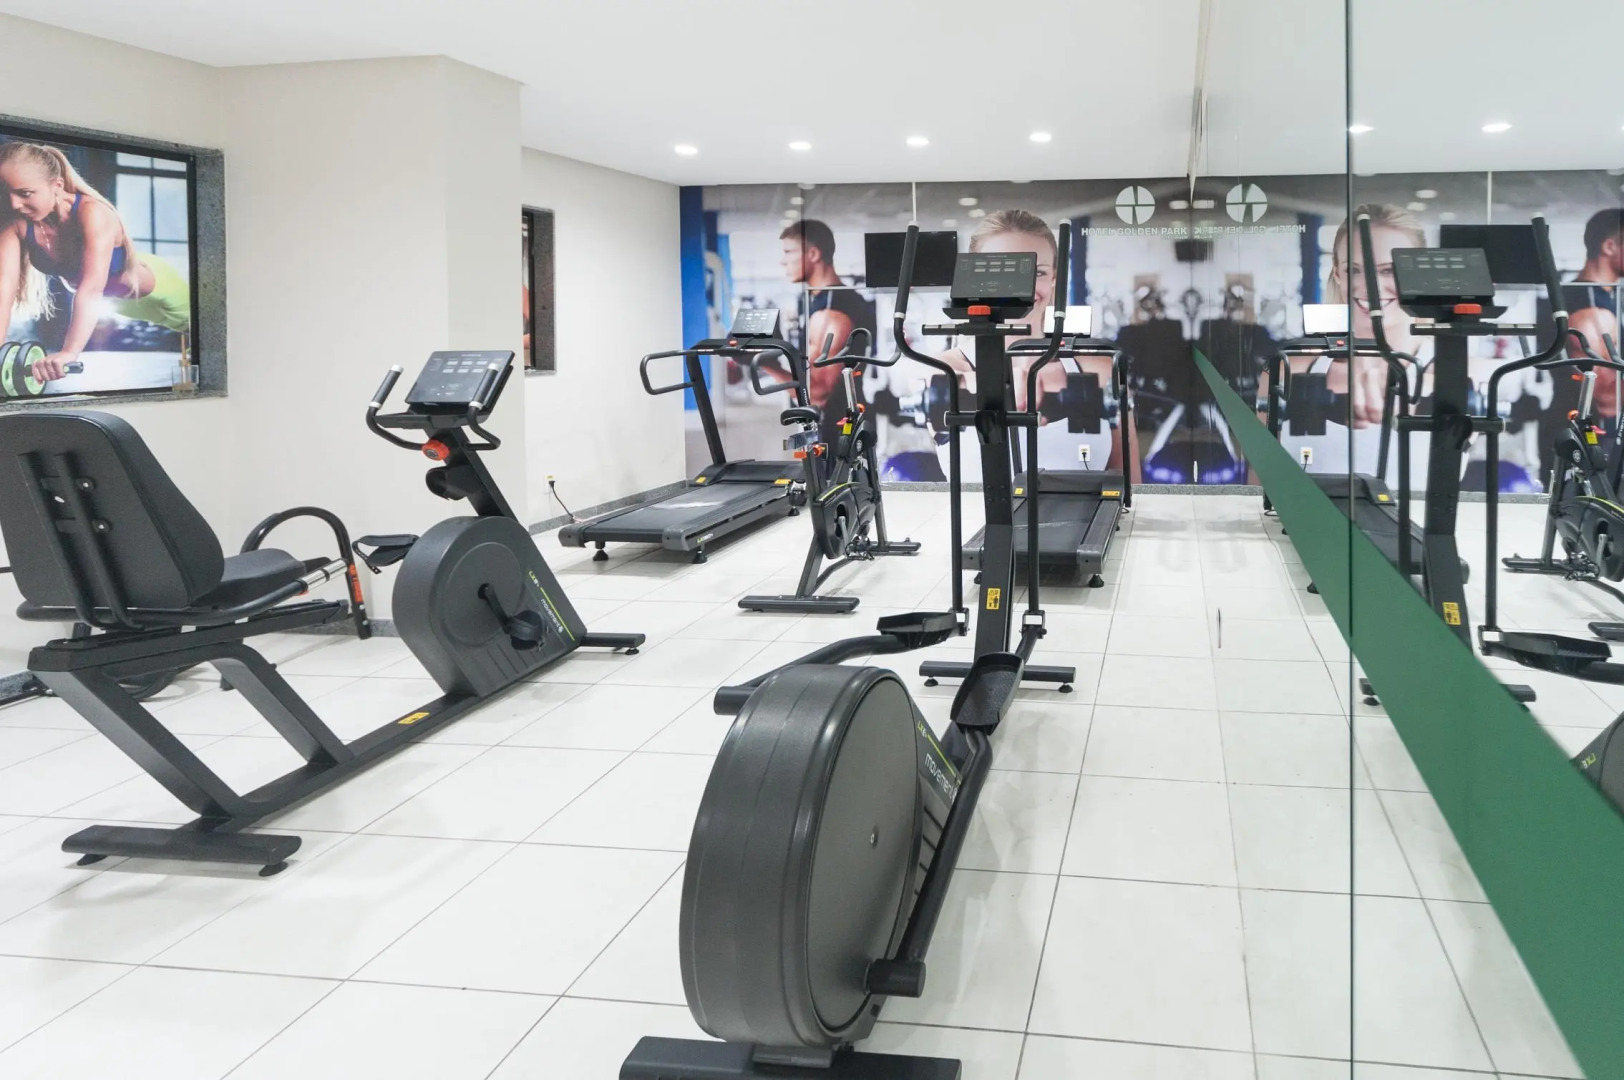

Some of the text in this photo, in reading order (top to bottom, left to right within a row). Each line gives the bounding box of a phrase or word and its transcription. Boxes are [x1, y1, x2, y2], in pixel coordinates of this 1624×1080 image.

[1081, 226, 1187, 236] HOTEL GOLDEN PARK
[540, 598, 561, 628] movement
[924, 753, 954, 799] movement
